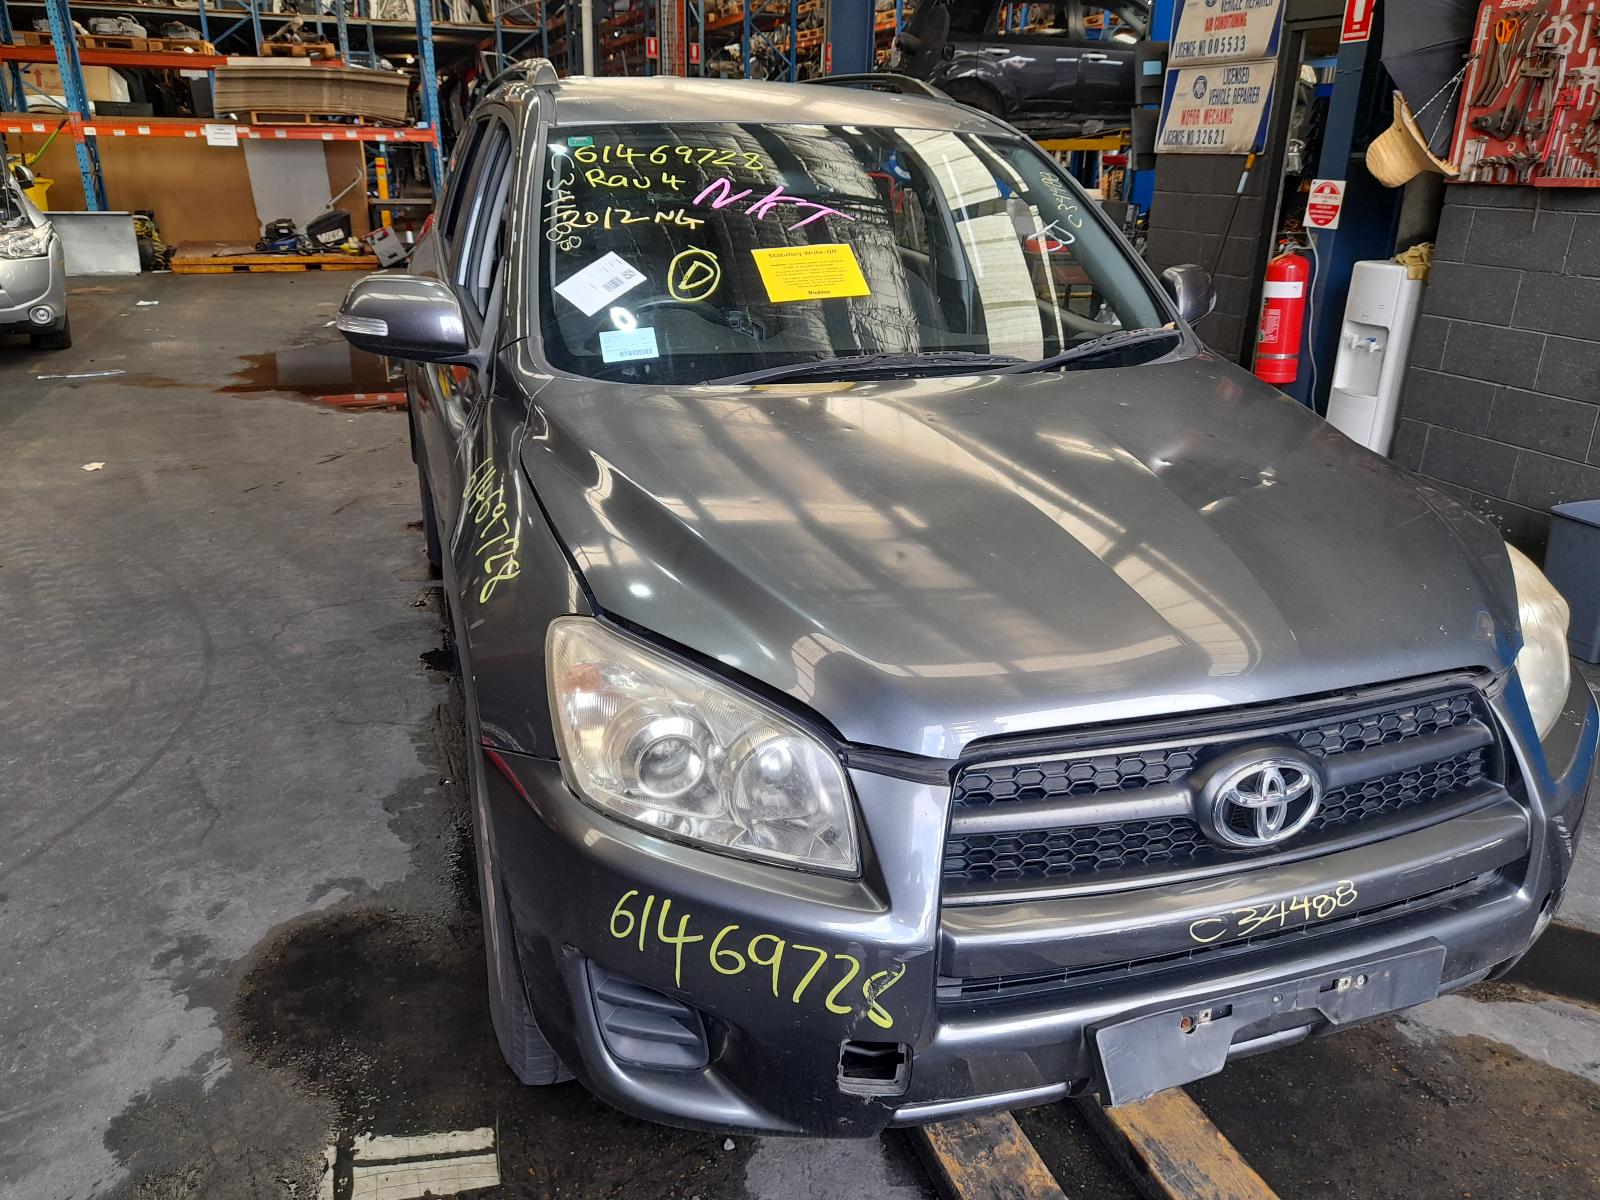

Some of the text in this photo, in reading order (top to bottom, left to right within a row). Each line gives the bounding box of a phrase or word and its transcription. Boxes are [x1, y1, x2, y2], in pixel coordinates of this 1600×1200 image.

[1208, 35, 1246, 54] 005533
[1223, 67, 1250, 85] LICENSED
[1208, 86, 1260, 105] VEHICLE REPAIRER
[1180, 107, 1234, 126] MOTOR MECHANIC
[1196, 129, 1225, 144] 32621
[574, 144, 764, 170] 61469728
[662, 171, 687, 191] 4
[609, 889, 906, 1029] 61469728
